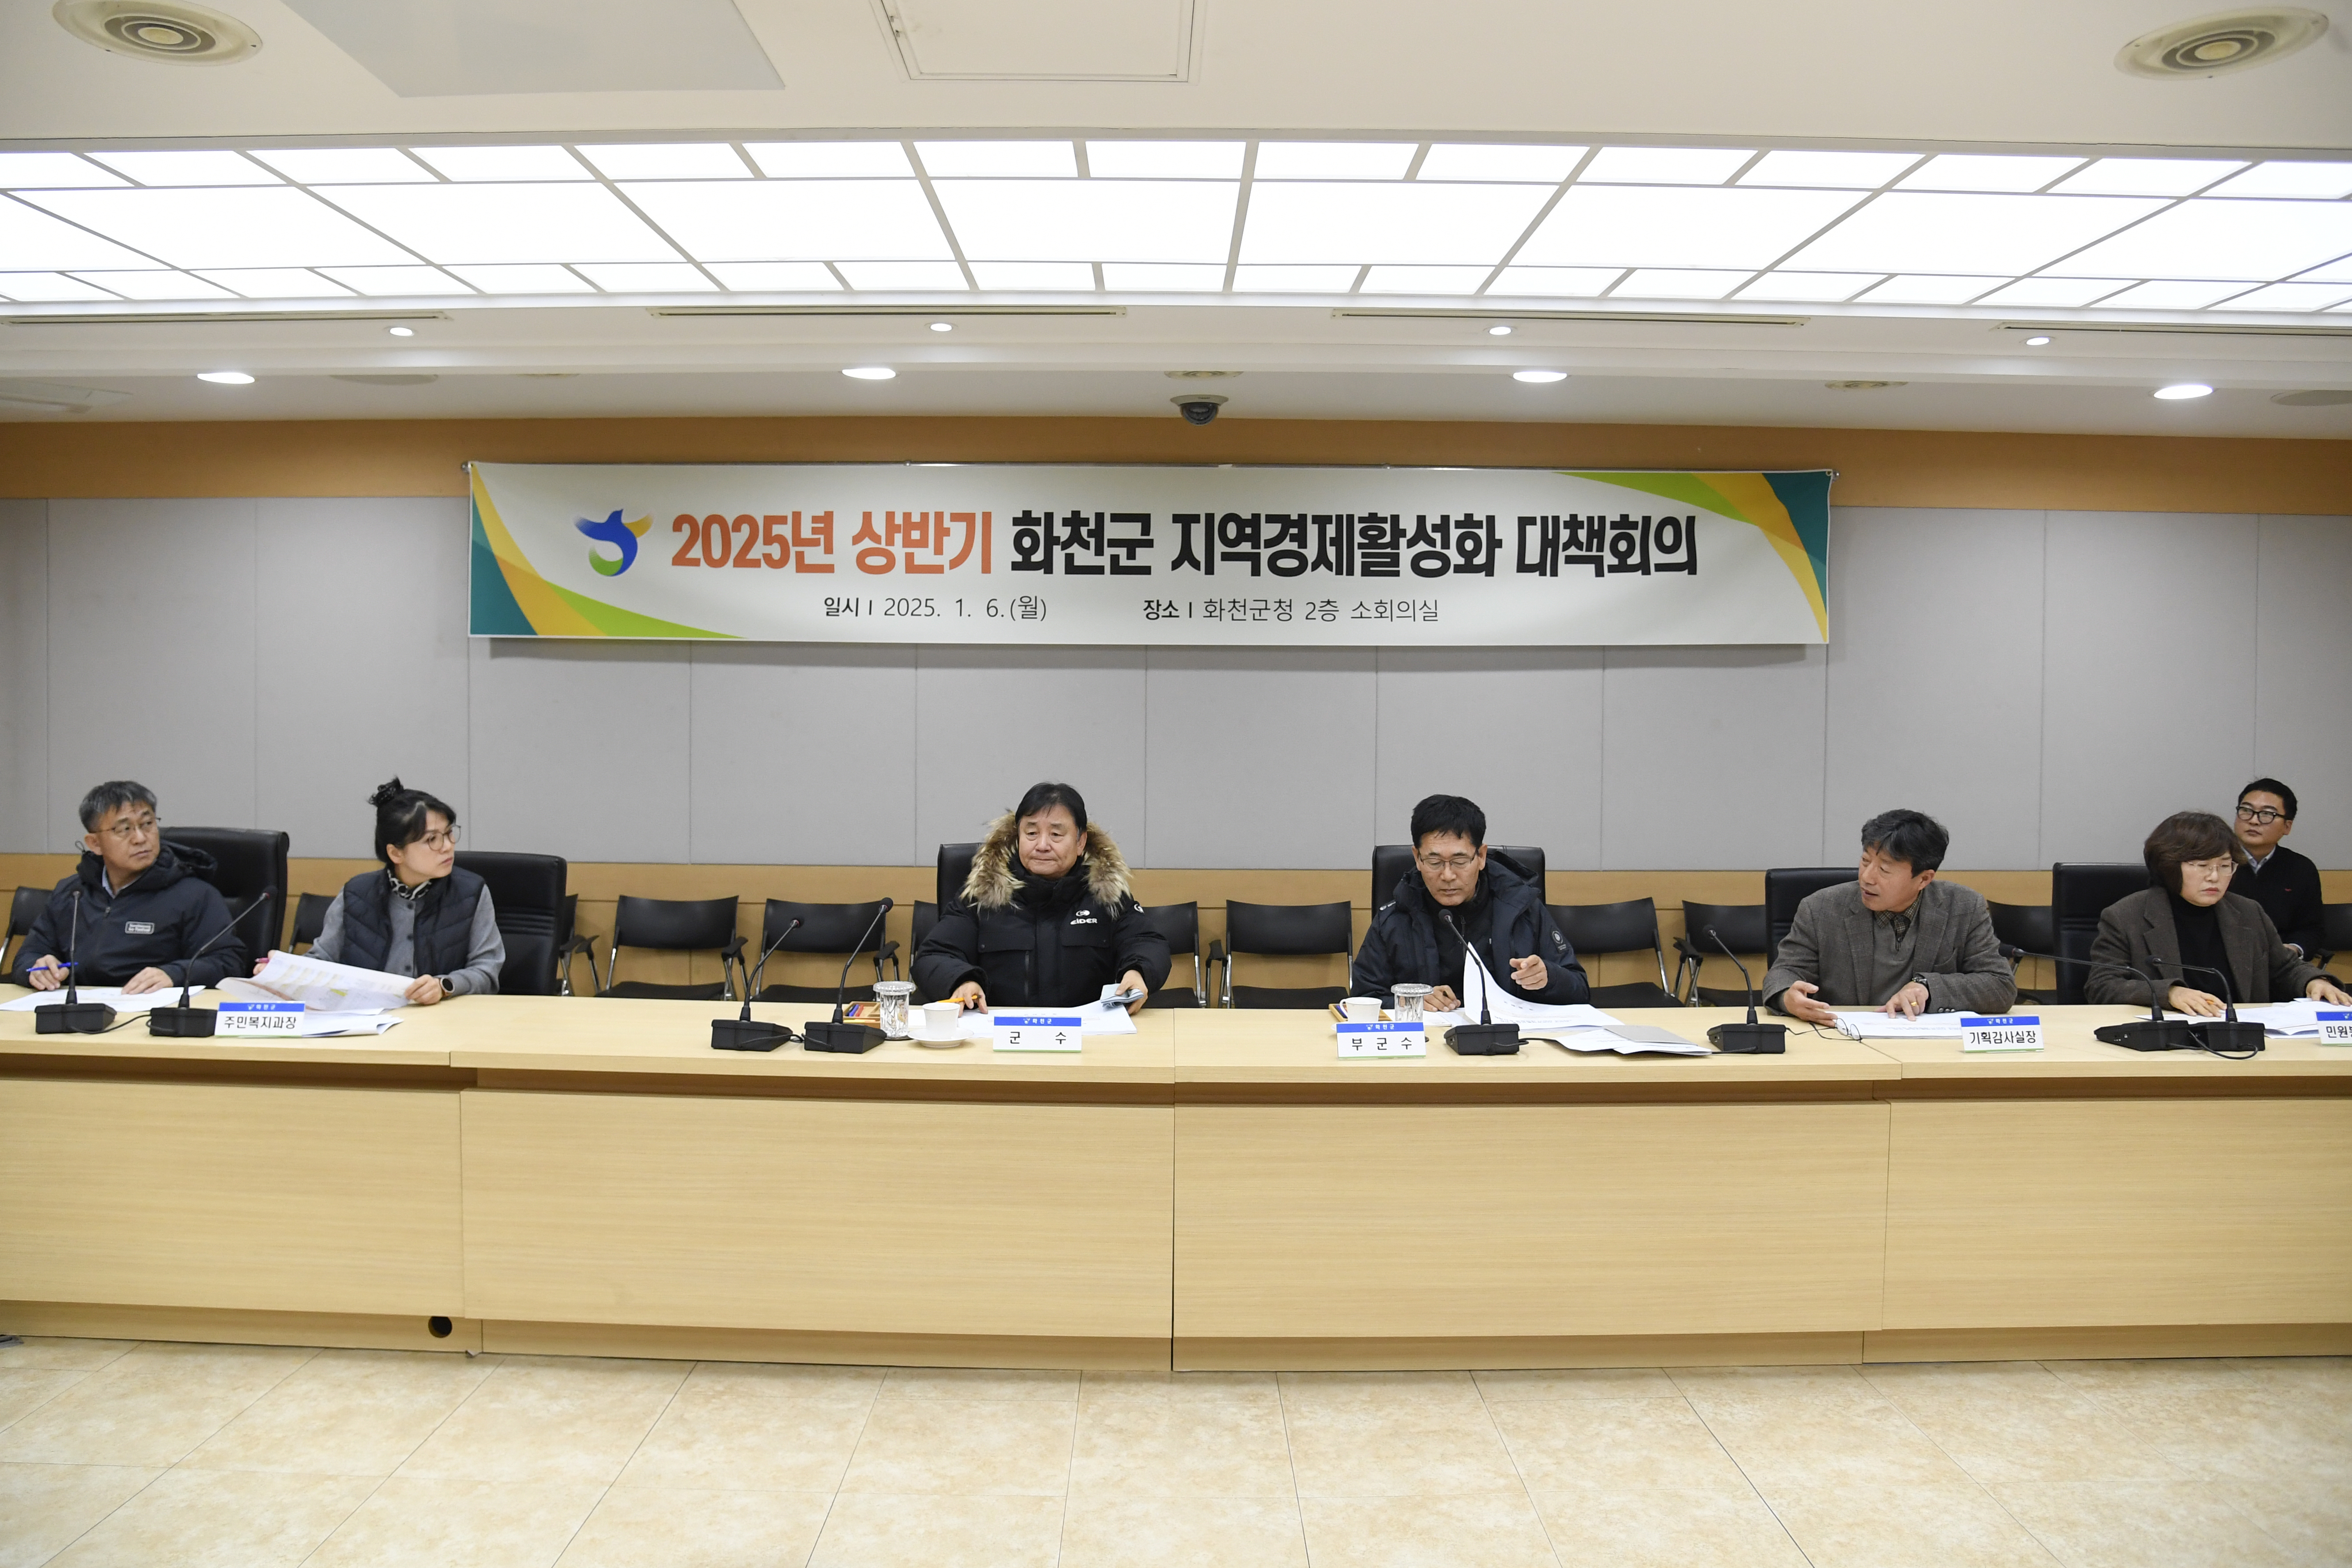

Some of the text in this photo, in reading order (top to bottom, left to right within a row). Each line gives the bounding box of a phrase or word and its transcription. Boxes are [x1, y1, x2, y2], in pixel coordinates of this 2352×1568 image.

[672, 510, 1698, 578] 2025년 상반기 화천군 지역경제활성화 대책회의
[824, 597, 859, 617] 일시
[884, 598, 940, 617] 2025.
[956, 598, 971, 617] 1.
[1143, 599, 1180, 620] 장소
[1203, 598, 1292, 622] 화천군청
[1305, 599, 1339, 622] 2층
[1350, 599, 1438, 622] 소회의실
[224, 1016, 296, 1029] 주민복지과장
[1969, 1030, 2036, 1045] 기획감사실장
